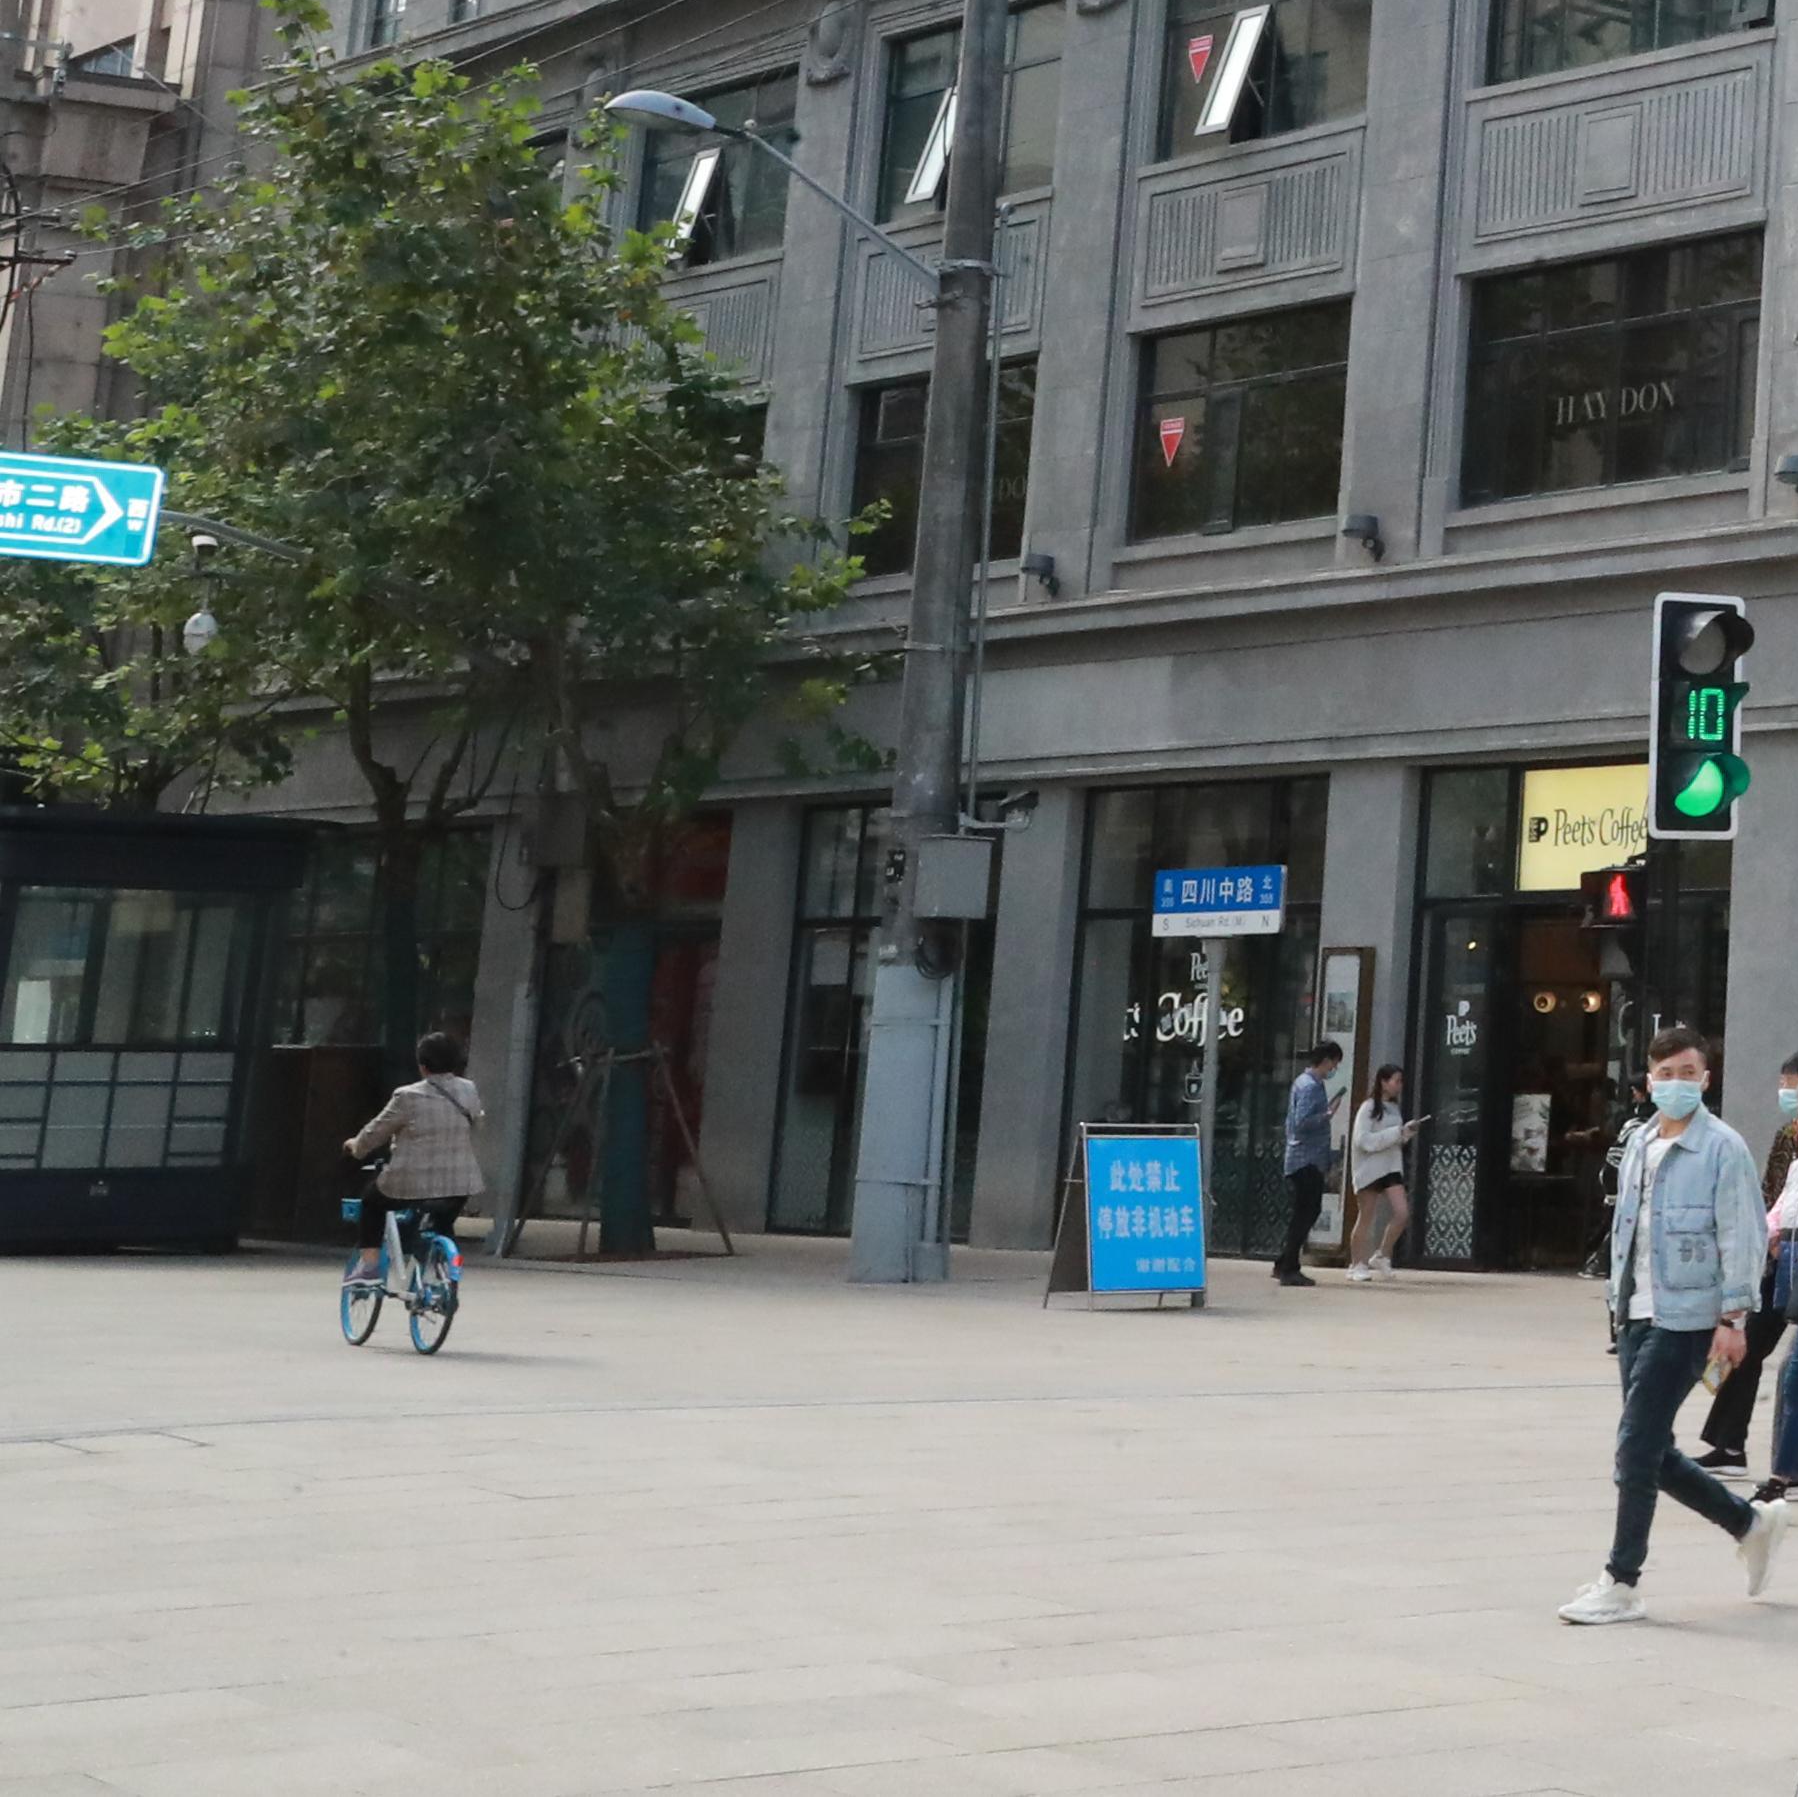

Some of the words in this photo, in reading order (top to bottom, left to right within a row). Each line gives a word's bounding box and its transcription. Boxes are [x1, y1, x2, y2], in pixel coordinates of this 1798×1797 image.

[1688, 688, 1724, 740] 10
[1181, 876, 1254, 905] 四川中路
